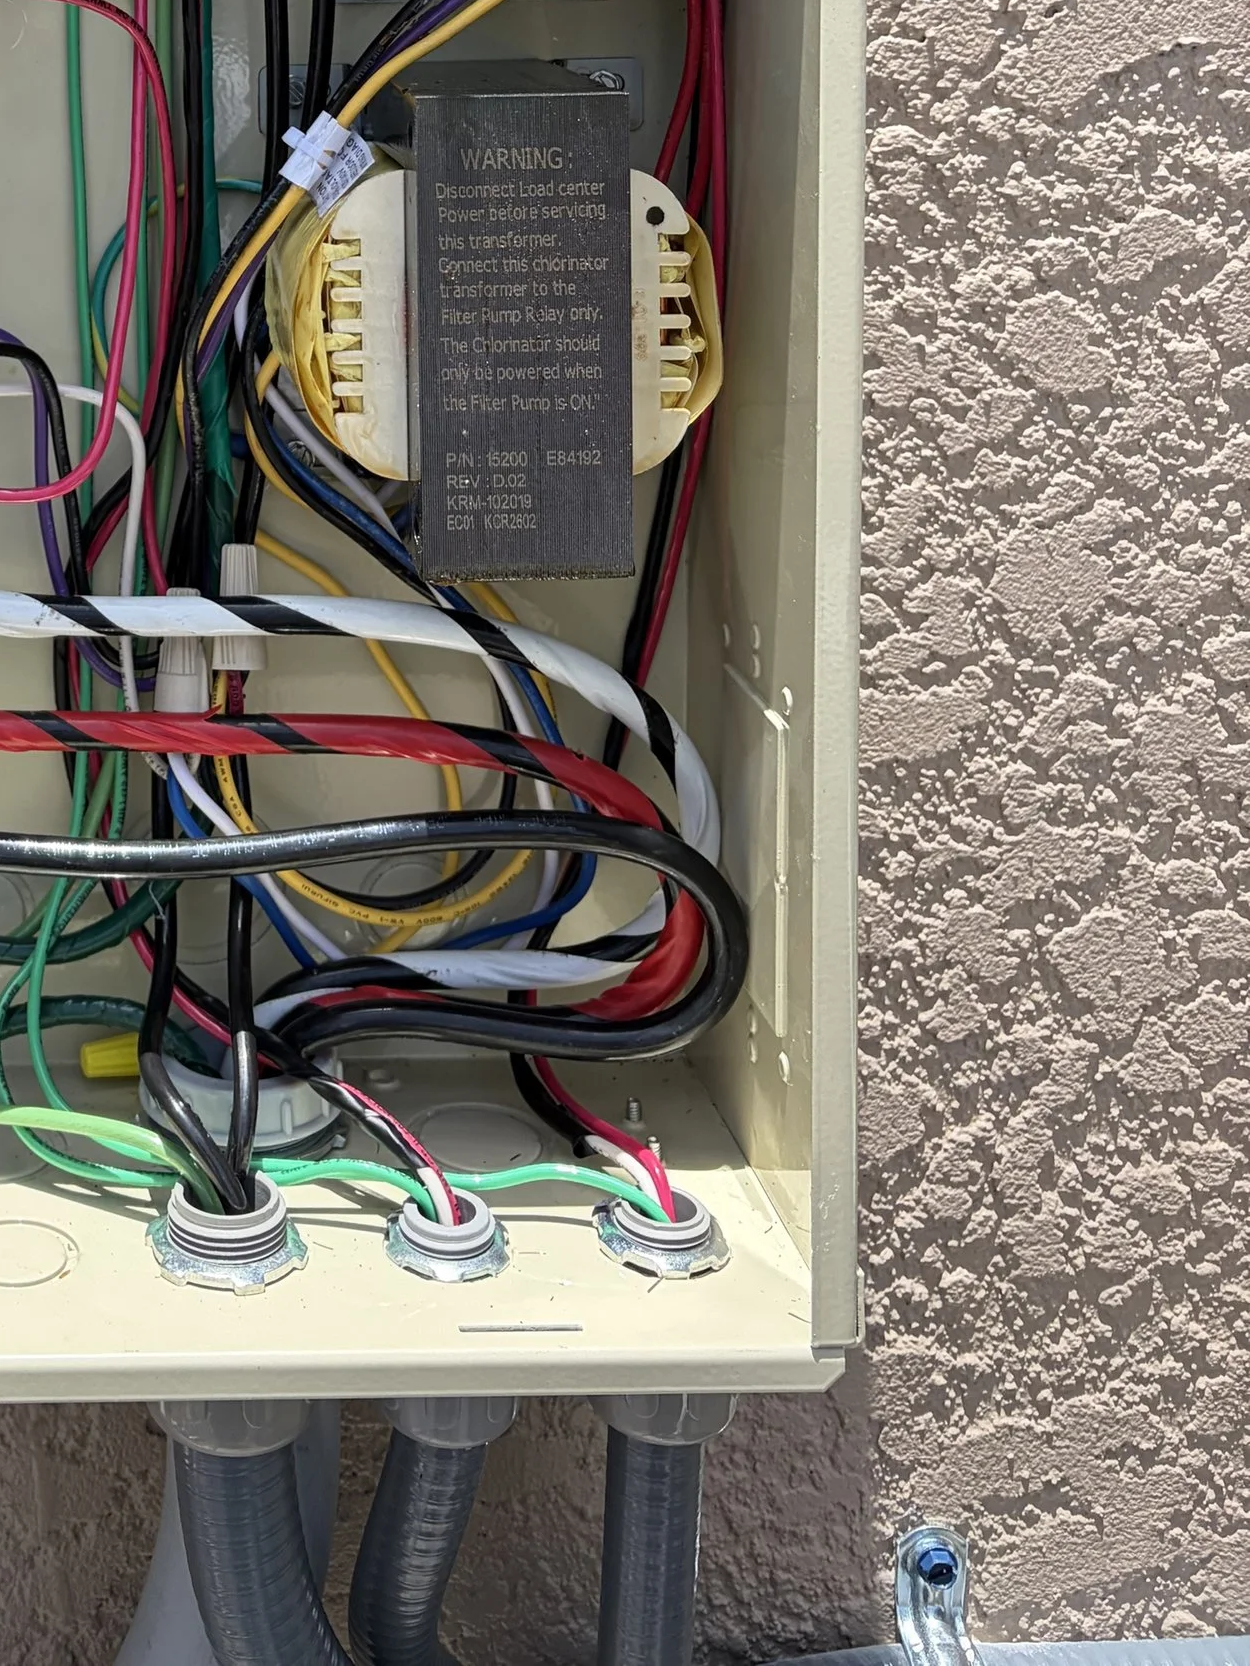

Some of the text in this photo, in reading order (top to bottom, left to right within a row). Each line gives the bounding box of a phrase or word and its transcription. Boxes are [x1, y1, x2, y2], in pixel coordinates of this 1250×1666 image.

[460, 147, 563, 171] WARNING
[435, 181, 605, 199] Disconnect Load center
[438, 203, 606, 223] Power before servicing
[438, 232, 562, 250] this transformer.
[438, 255, 609, 274] Connect this chlorinator
[440, 280, 576, 298] transformer to the
[441, 306, 603, 326] Filter Pump Relay only.
[440, 335, 600, 354] The Chlorinator should
[441, 363, 602, 384] only be powered when
[444, 396, 467, 411] the
[471, 395, 506, 410] Filter
[511, 395, 550, 413] Pump
[555, 394, 565, 410] is
[446, 450, 601, 468] P/N 15200 E84192
[447, 474, 526, 490] REV D.02
[447, 494, 532, 511] KRM-102019
[447, 513, 536, 531] EC01 KCR2602
